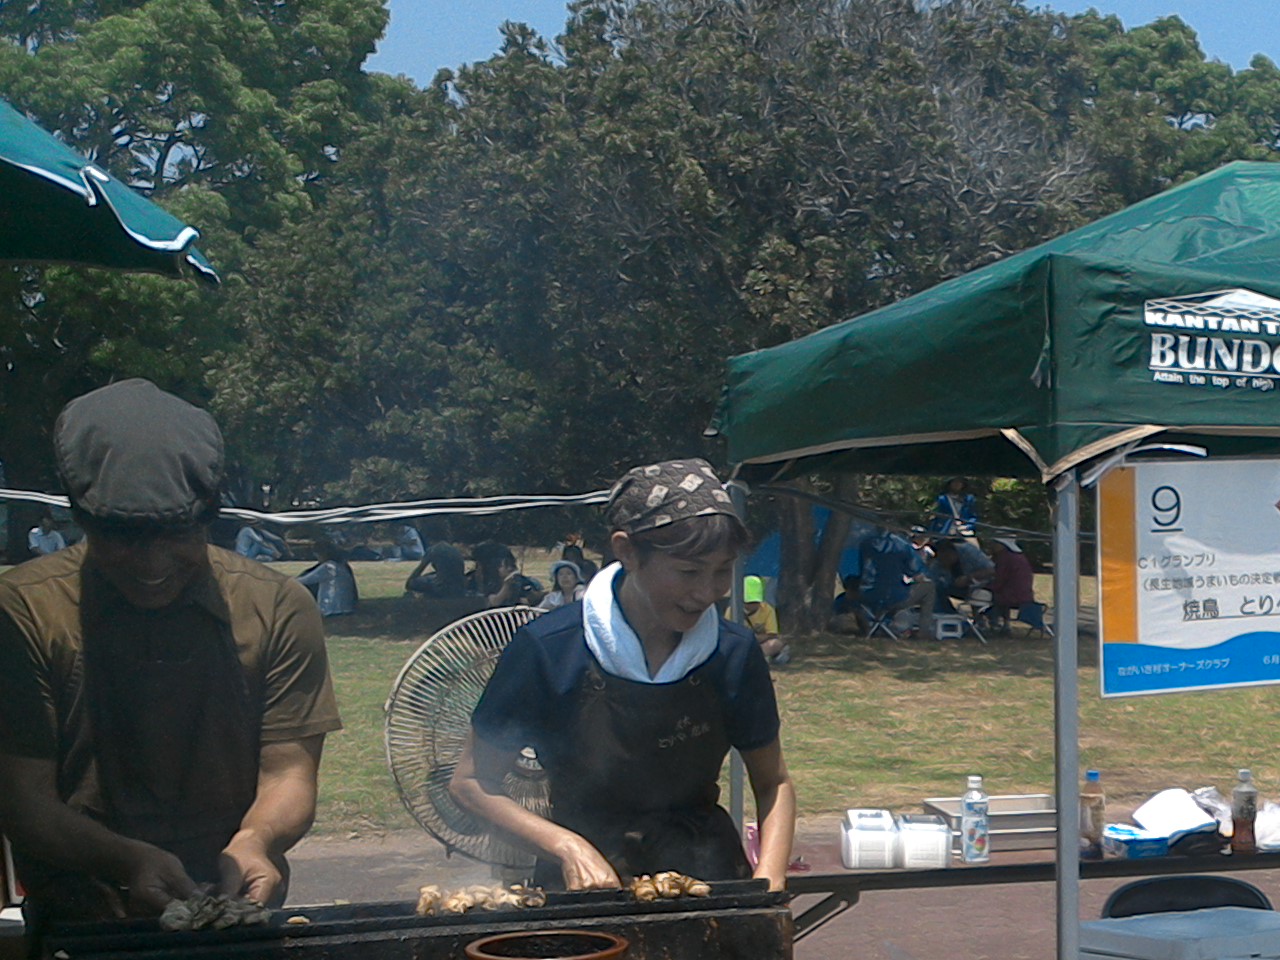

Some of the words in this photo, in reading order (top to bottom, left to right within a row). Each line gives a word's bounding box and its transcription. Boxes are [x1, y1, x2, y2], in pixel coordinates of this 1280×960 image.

[1145, 311, 1260, 334] KANTAN
[1153, 371, 1183, 384] Attain
[1189, 374, 1206, 386] the
[1212, 375, 1230, 389] top
[1236, 376, 1248, 388] of
[1252, 377, 1275, 392] high
[1151, 485, 1182, 527] 9
[1183, 598, 1219, 620] 焼鳥
